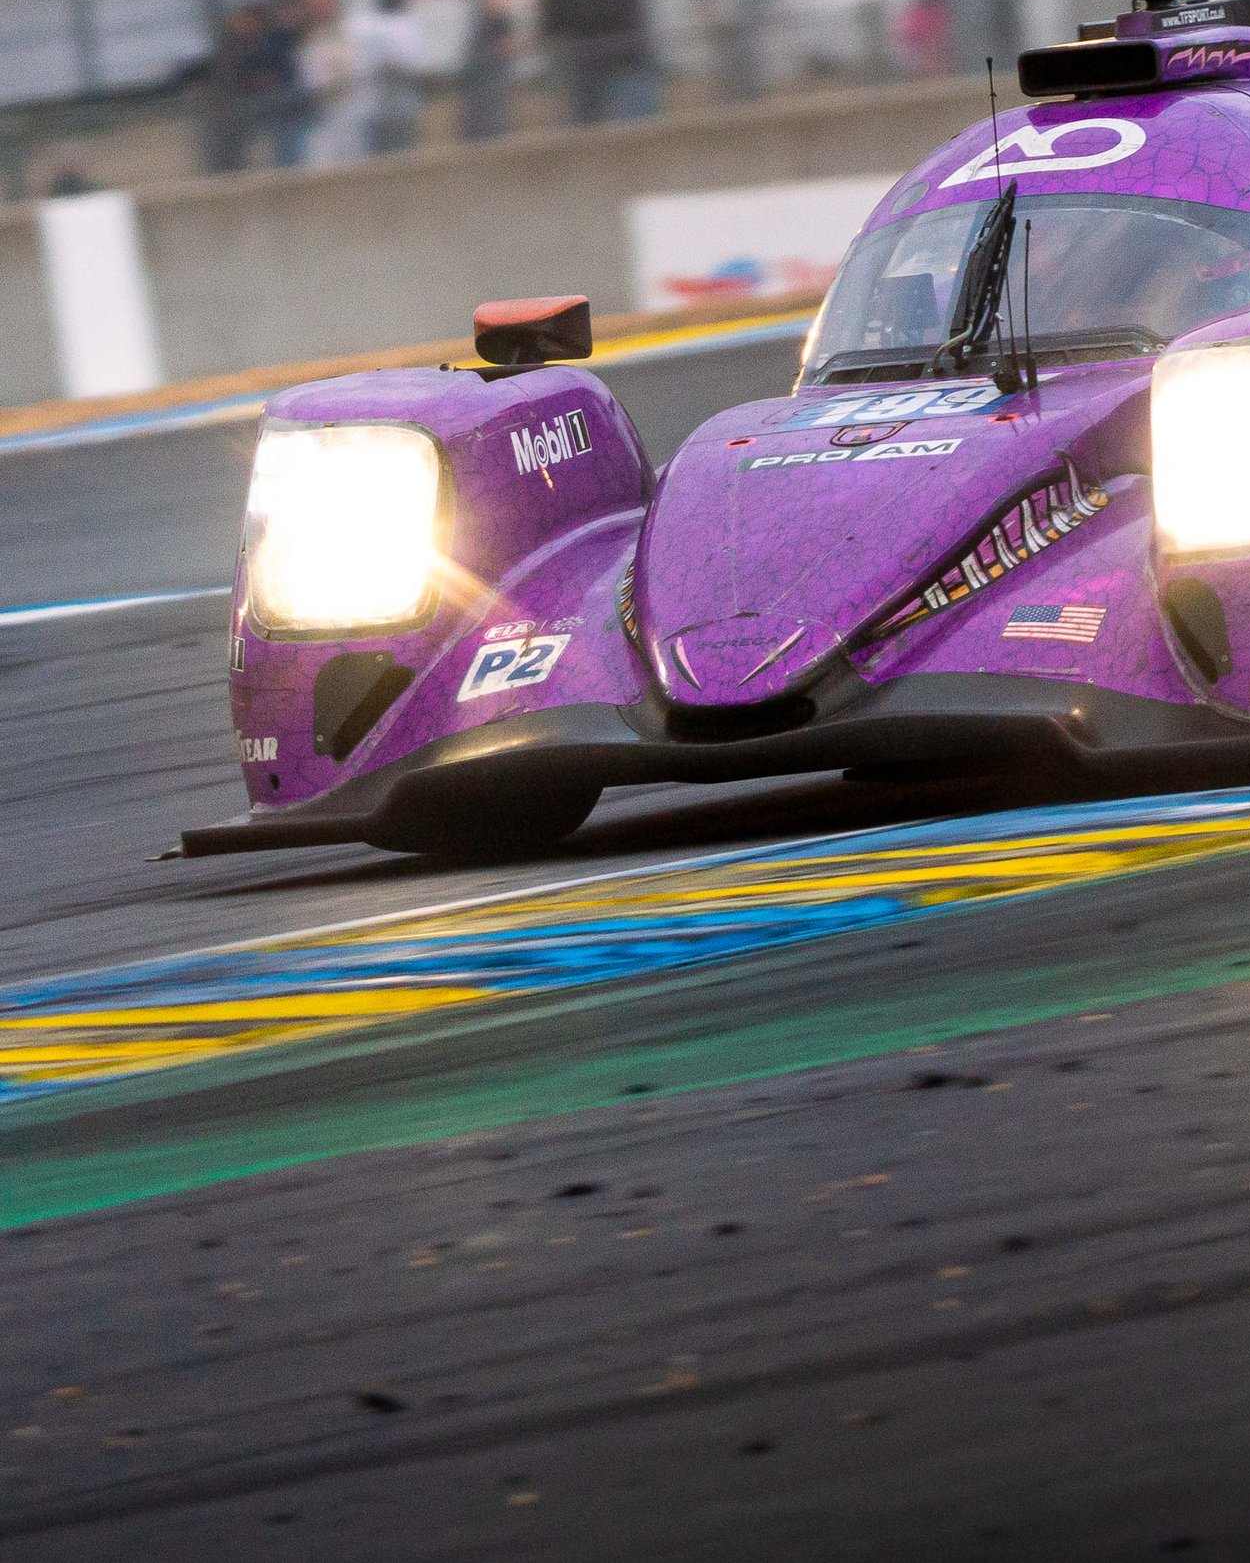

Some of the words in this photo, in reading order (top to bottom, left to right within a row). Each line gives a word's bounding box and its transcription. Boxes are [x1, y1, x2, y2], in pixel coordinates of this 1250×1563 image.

[810, 386, 1003, 426] 199
[510, 415, 573, 475] Mobil
[750, 449, 852, 470] PRO
[873, 441, 953, 457] AM
[468, 643, 556, 692] P2
